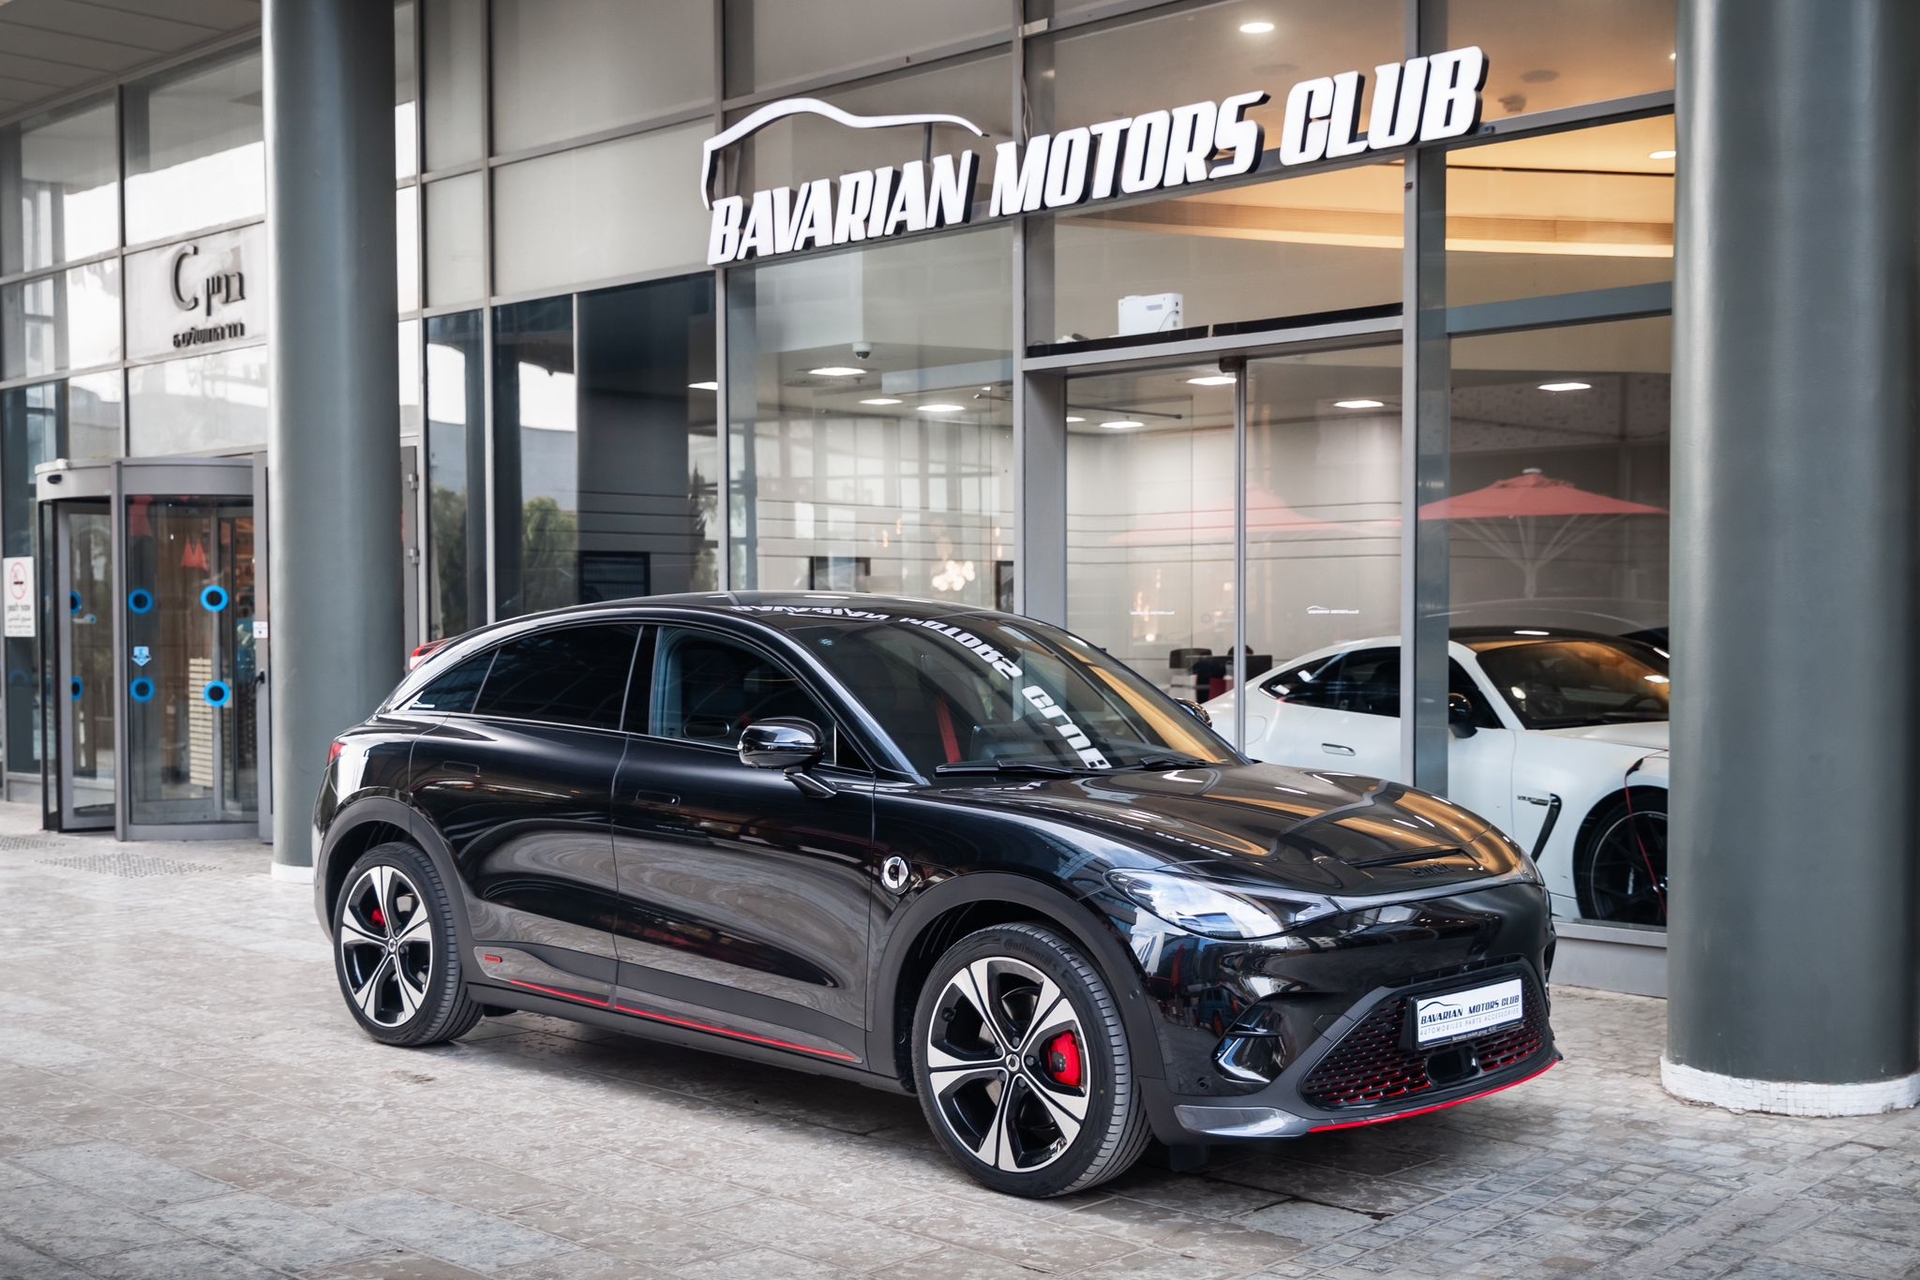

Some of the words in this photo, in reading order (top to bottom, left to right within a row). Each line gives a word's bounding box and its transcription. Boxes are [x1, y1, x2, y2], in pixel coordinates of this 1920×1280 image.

[707, 150, 976, 265] BAVARIAN
[989, 90, 1268, 217] MOTORS
[1279, 46, 1486, 166] CLUB
[170, 244, 199, 312] C
[1420, 1007, 1464, 1025] BAVARIAN
[1468, 999, 1500, 1015] MOTORS
[1501, 994, 1520, 1007] CLUB
[1420, 1021, 1463, 1036] AUTOMOBILES
[1464, 1017, 1482, 1027] PARTS
